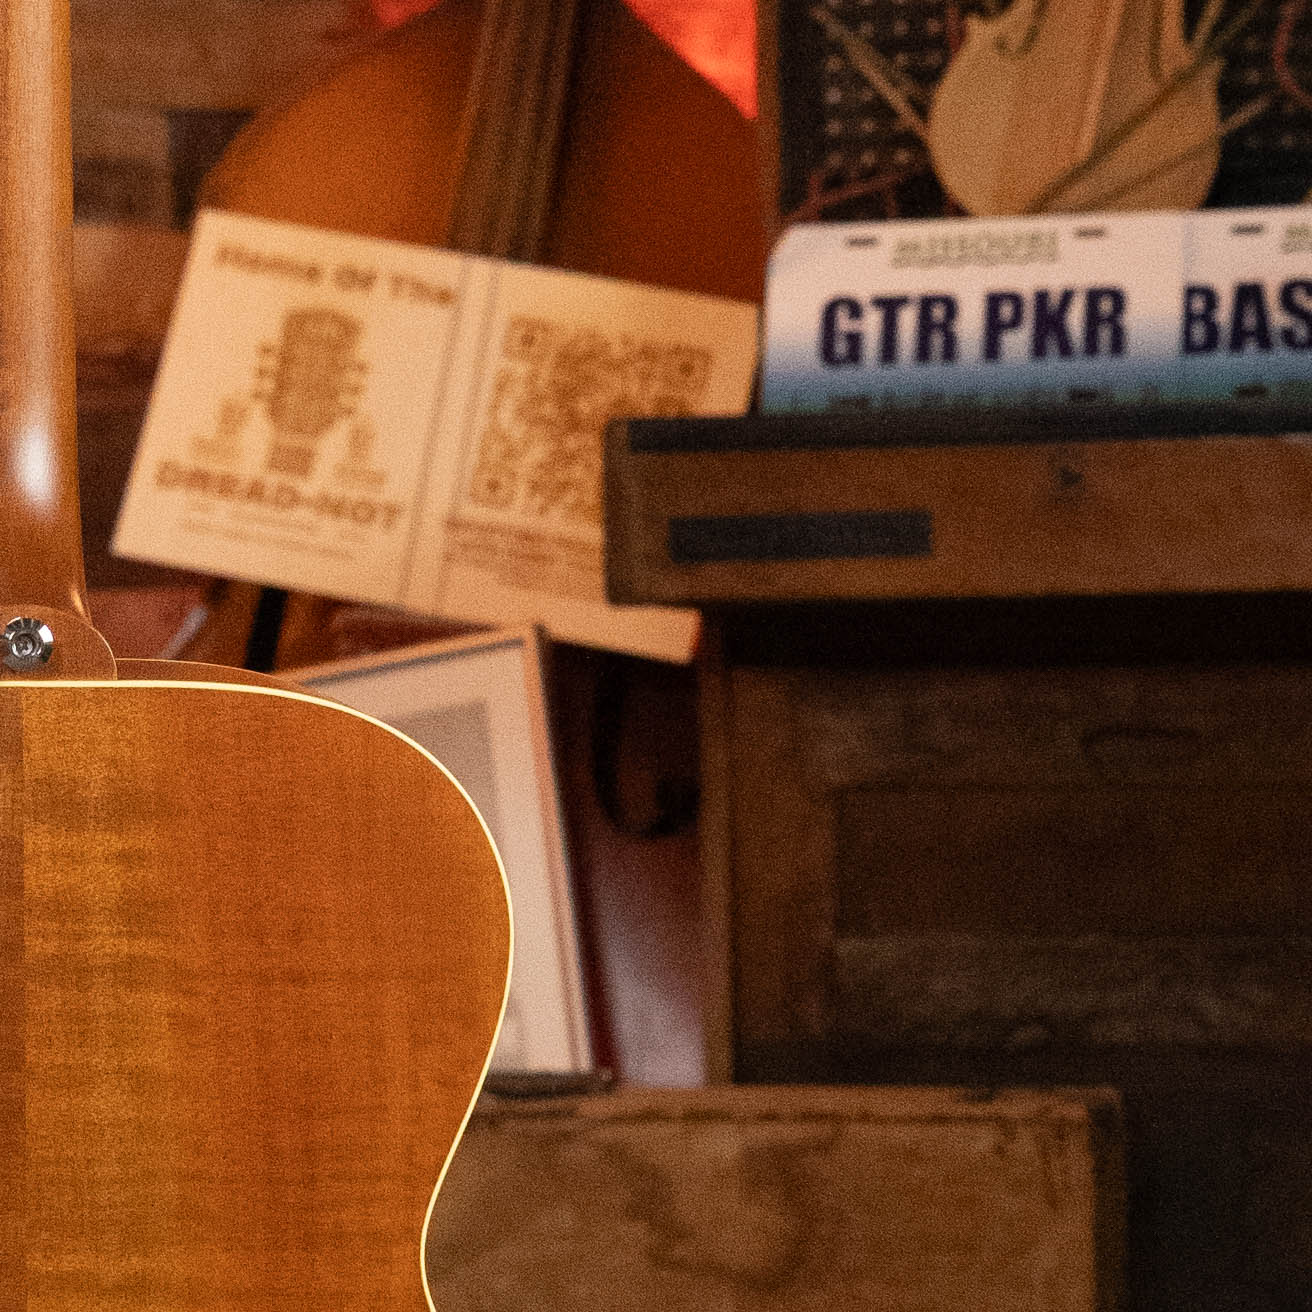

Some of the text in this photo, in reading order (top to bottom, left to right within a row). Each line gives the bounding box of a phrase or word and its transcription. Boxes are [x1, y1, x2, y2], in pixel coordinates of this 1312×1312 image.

[820, 286, 1128, 369] GTR PKR
[1182, 276, 1312, 358] BAS
